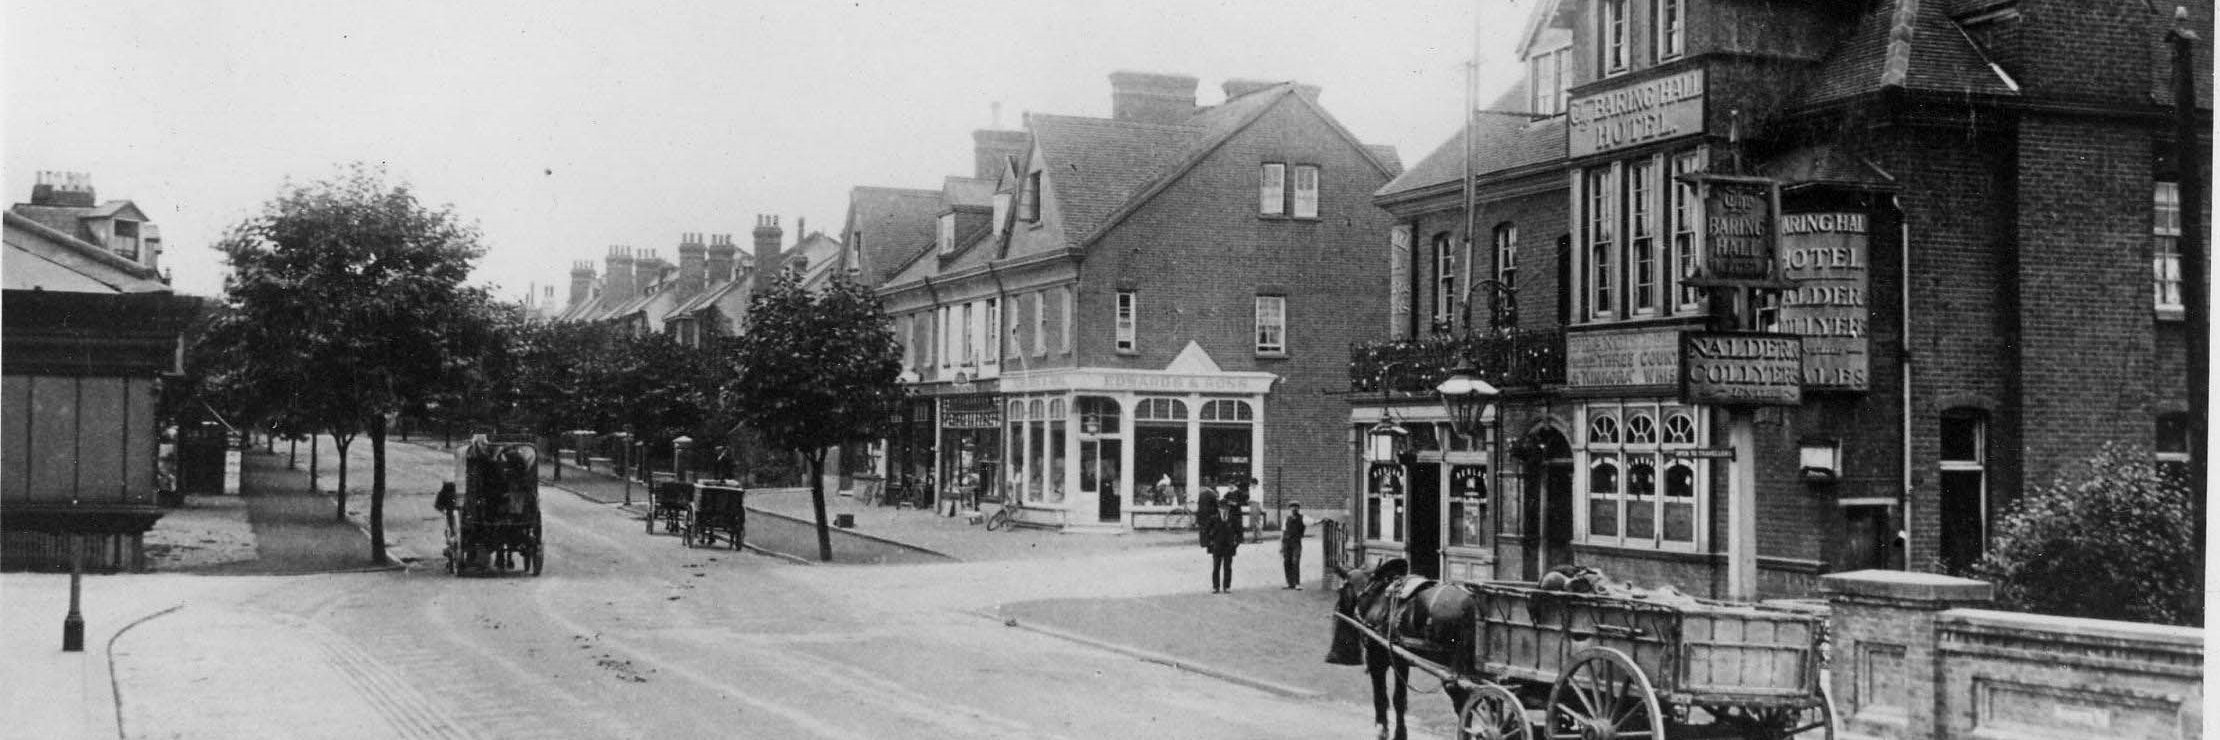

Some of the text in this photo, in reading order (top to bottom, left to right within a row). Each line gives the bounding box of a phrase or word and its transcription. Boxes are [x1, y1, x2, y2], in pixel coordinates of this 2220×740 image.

[1594, 86, 1654, 121] BARING
[1658, 70, 1702, 107] HALL
[1709, 217, 1766, 237] BARING
[1782, 213, 1865, 234] ARING HAL
[1716, 238, 1760, 256] HALL
[1781, 287, 1864, 307] ALDER
